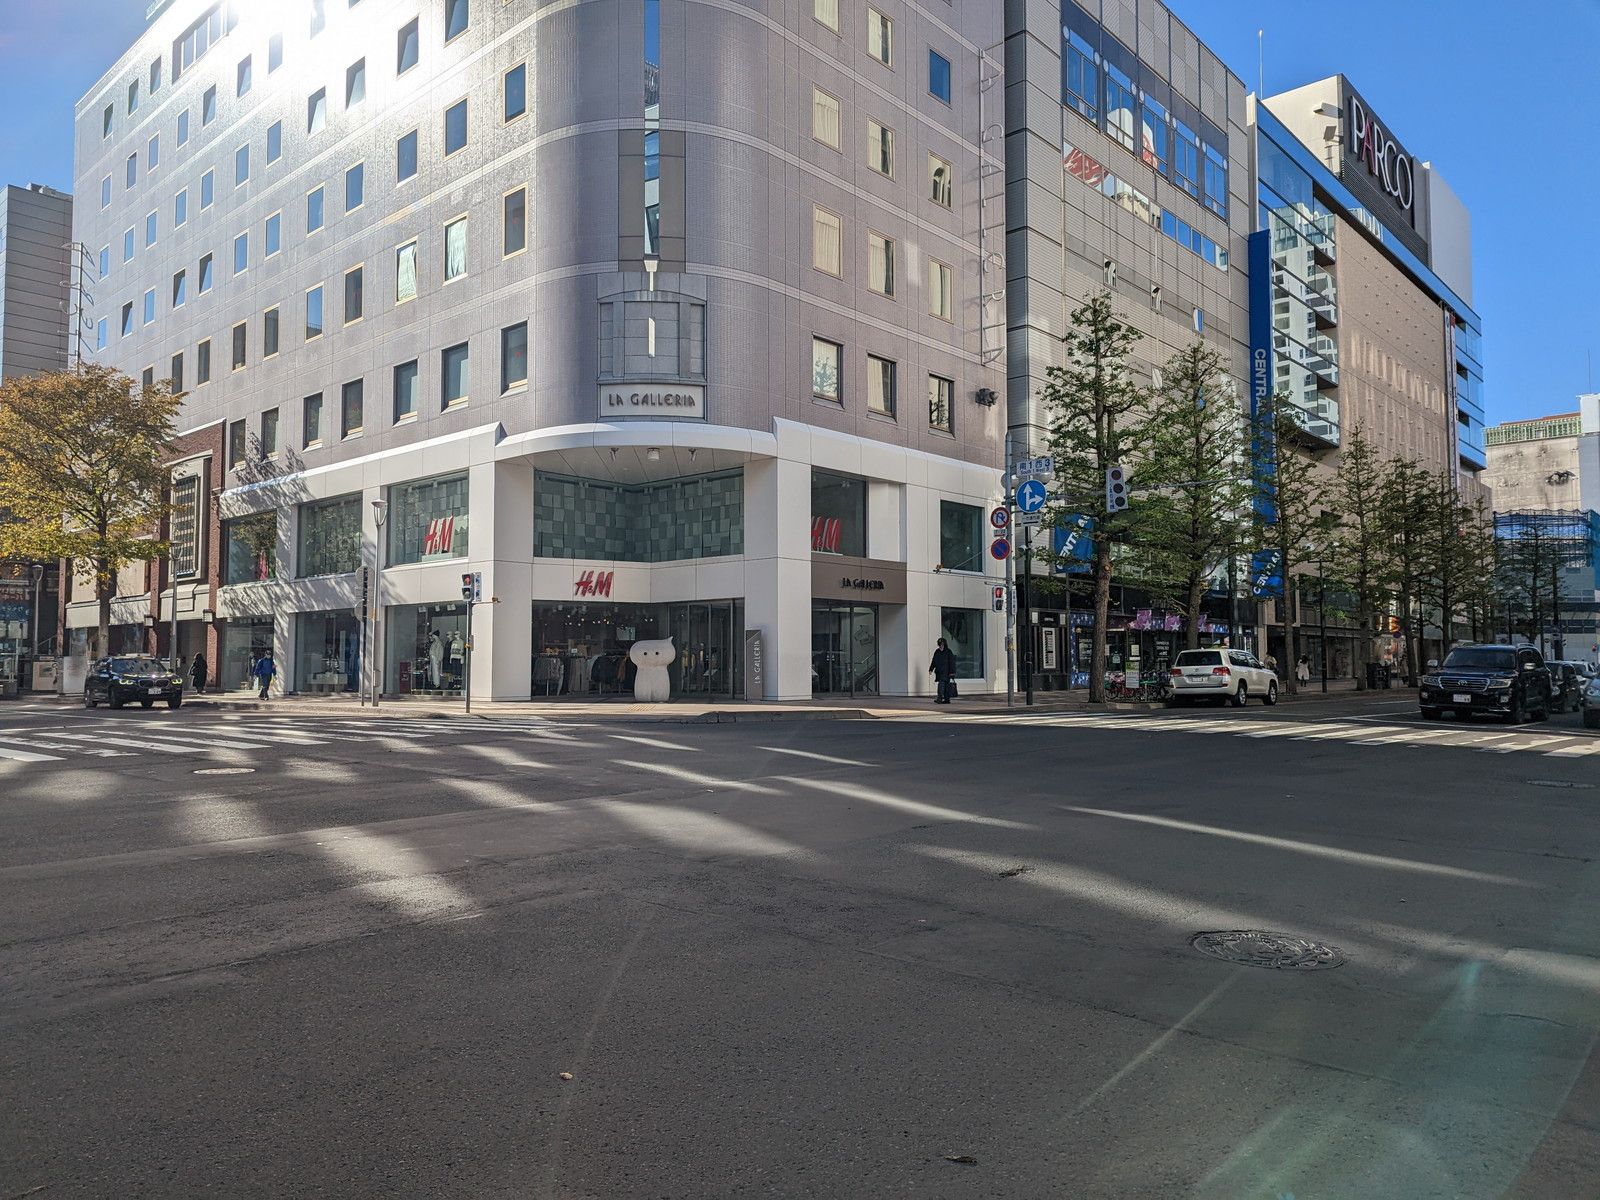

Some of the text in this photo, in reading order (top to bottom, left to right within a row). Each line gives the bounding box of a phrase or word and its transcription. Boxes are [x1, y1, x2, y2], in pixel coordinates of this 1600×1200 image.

[1350, 95, 1412, 210] PARCO
[608, 393, 696, 407] LA GALLERIA
[424, 516, 455, 555] H&M
[811, 516, 842, 553] H&M
[575, 570, 614, 598] H&M
[753, 640, 761, 684] LA GALLERIA
